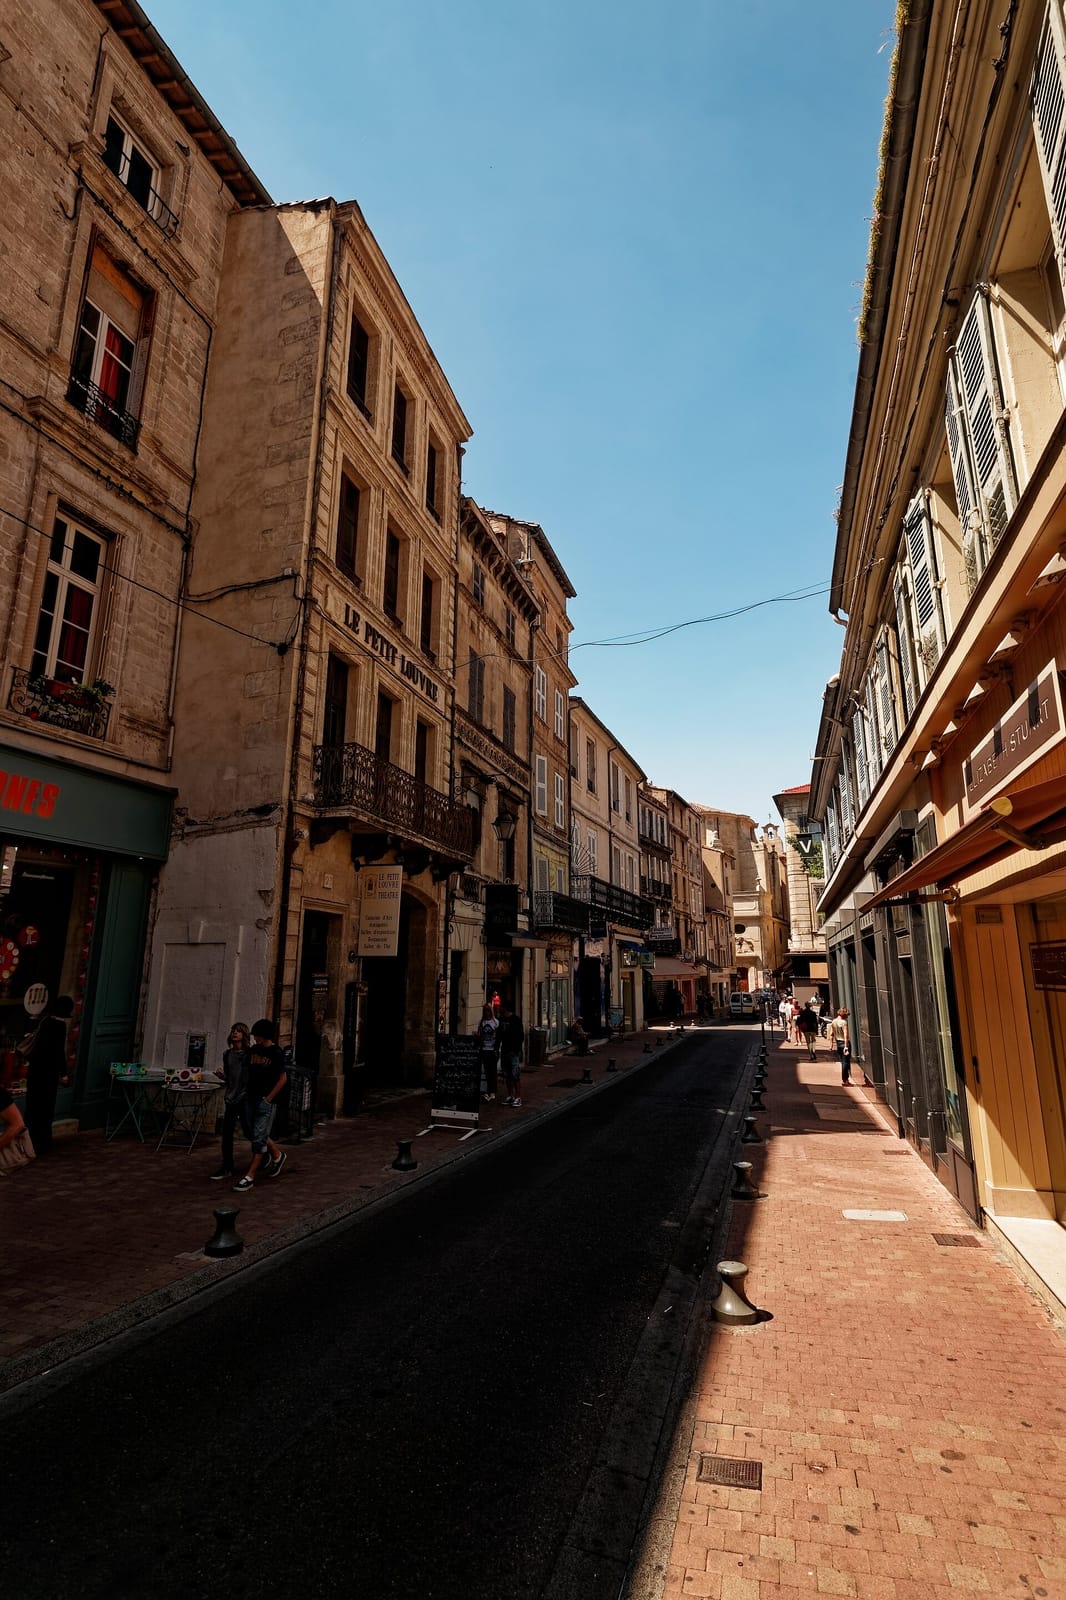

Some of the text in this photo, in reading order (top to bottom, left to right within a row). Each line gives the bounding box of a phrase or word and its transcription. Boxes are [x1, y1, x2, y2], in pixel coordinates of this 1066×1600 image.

[344, 603, 438, 703] LE PETIT LOUVRE
[799, 839, 812, 853] V
[378, 873, 400, 881] LE PETIT
[378, 880, 399, 889] LOUVRE
